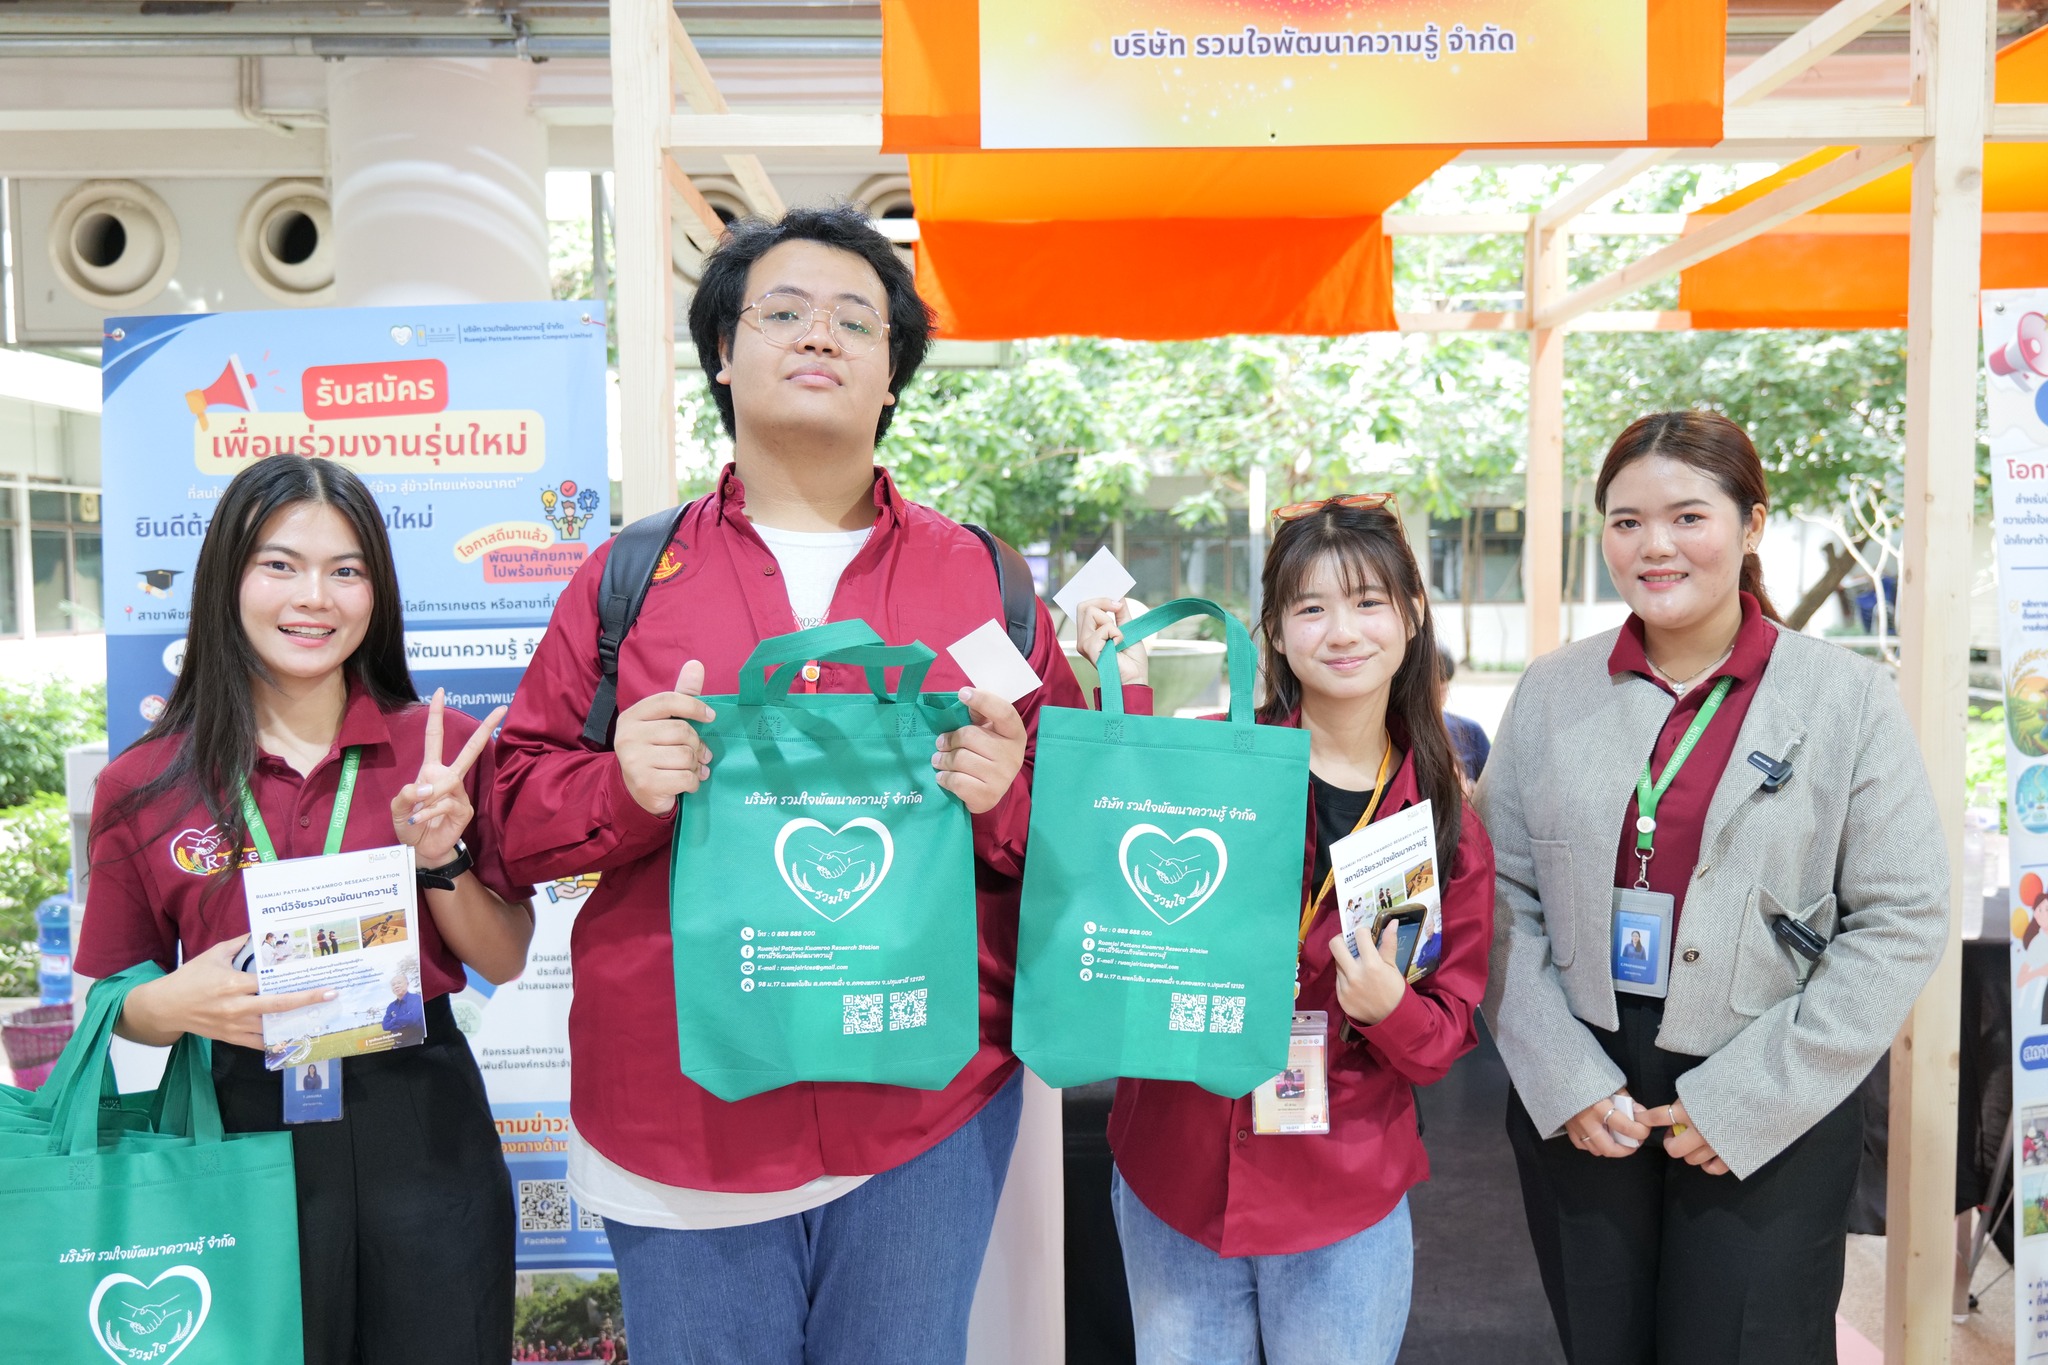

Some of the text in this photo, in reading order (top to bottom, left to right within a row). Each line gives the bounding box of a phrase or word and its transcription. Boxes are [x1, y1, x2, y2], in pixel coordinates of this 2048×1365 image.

[1113, 27, 1514, 59] บริษัท รวมใจพัฒนาความรู้ จำกัด
[315, 374, 435, 407] รับสมัคร
[212, 417, 527, 466] เพื่อนร่วมงานรุ่นใหม่
[457, 528, 549, 558] โอกาสดีมาแล้ว
[489, 549, 584, 564] พัฒนาศักยภาพ
[400, 599, 487, 613] โลยีการเกษตร
[491, 593, 559, 610] หรือสาขาที่เ
[1655, 725, 1701, 791] WWW.PINEHURST.CO.TH
[745, 791, 923, 809] บริษัท รวมใจพัฒนาความรู้ จำกัด
[1093, 796, 1257, 823] บริษัท รวมใจพัฒนาความรู้ จำกัด
[261, 883, 399, 915] สถานีวิจัยรวมใจพัฒนาความรู้
[283, 886, 310, 896] PATTANA
[311, 881, 342, 891] KWAMROO
[345, 876, 374, 886] RESEARCH
[376, 873, 400, 881] STATION
[60, 1233, 236, 1263] บริษัท รวมใจพัฒนาความรู้ จำกัด
[524, 1236, 609, 1245] Facebook Lin
